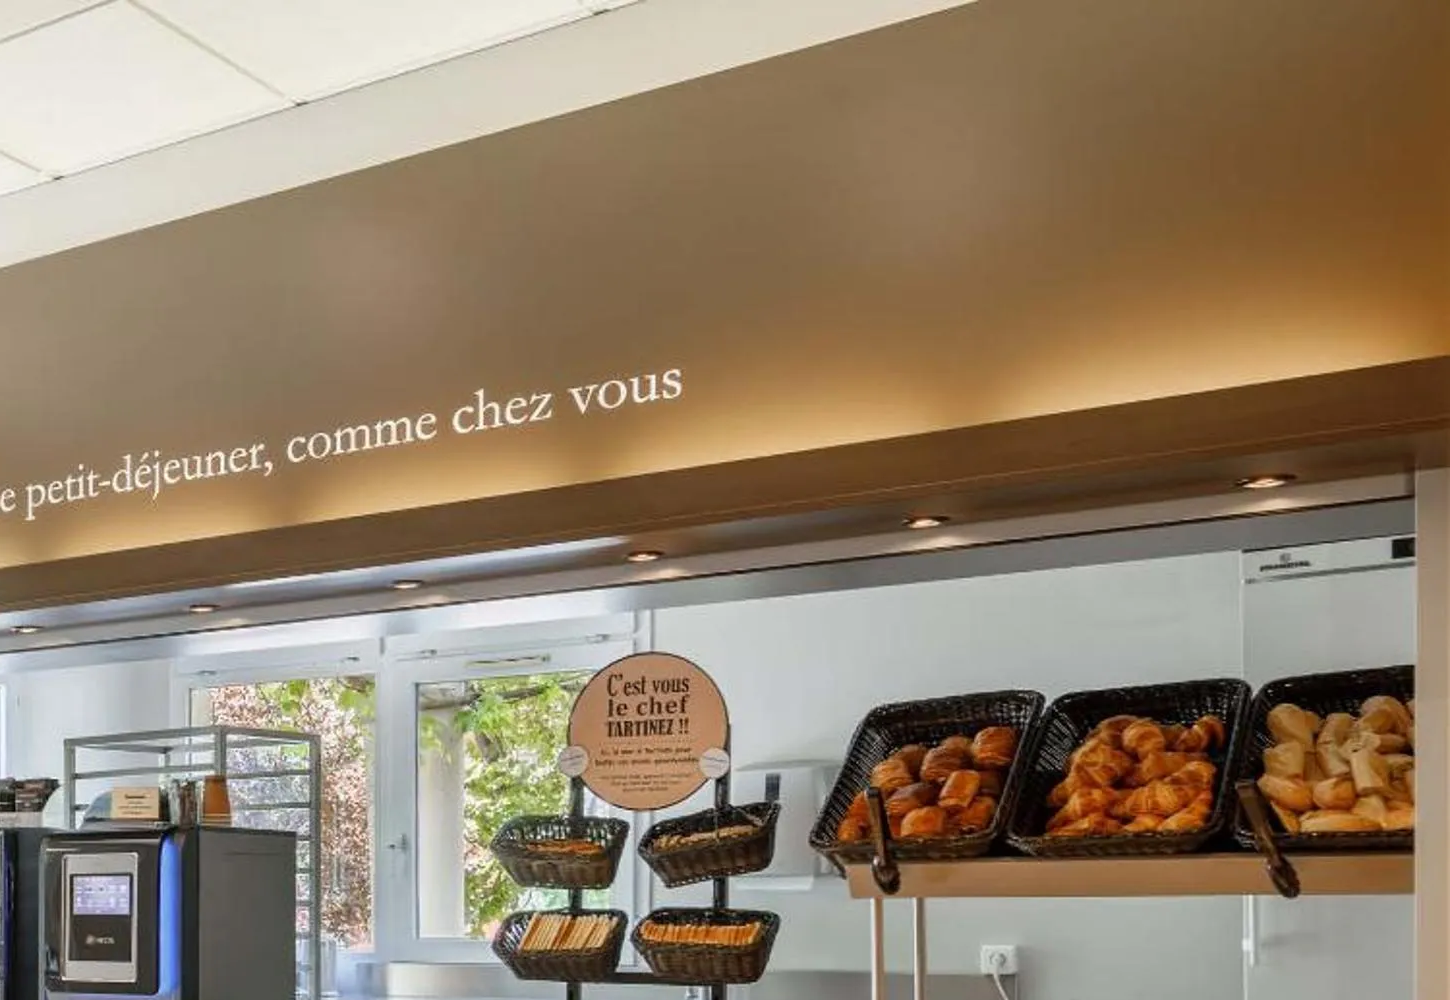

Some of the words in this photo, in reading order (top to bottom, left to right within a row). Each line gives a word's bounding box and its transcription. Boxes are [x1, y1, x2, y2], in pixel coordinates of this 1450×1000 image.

[24, 443, 274, 522] petit-déjeuner,
[285, 412, 438, 463] comme
[451, 387, 553, 434] chez
[567, 368, 683, 415] vous
[607, 674, 647, 697] C'est
[652, 677, 690, 694] vous
[607, 699, 628, 717] le
[636, 694, 690, 716] chef
[607, 718, 674, 738] TARTINEZ
[678, 718, 690, 735] !!
